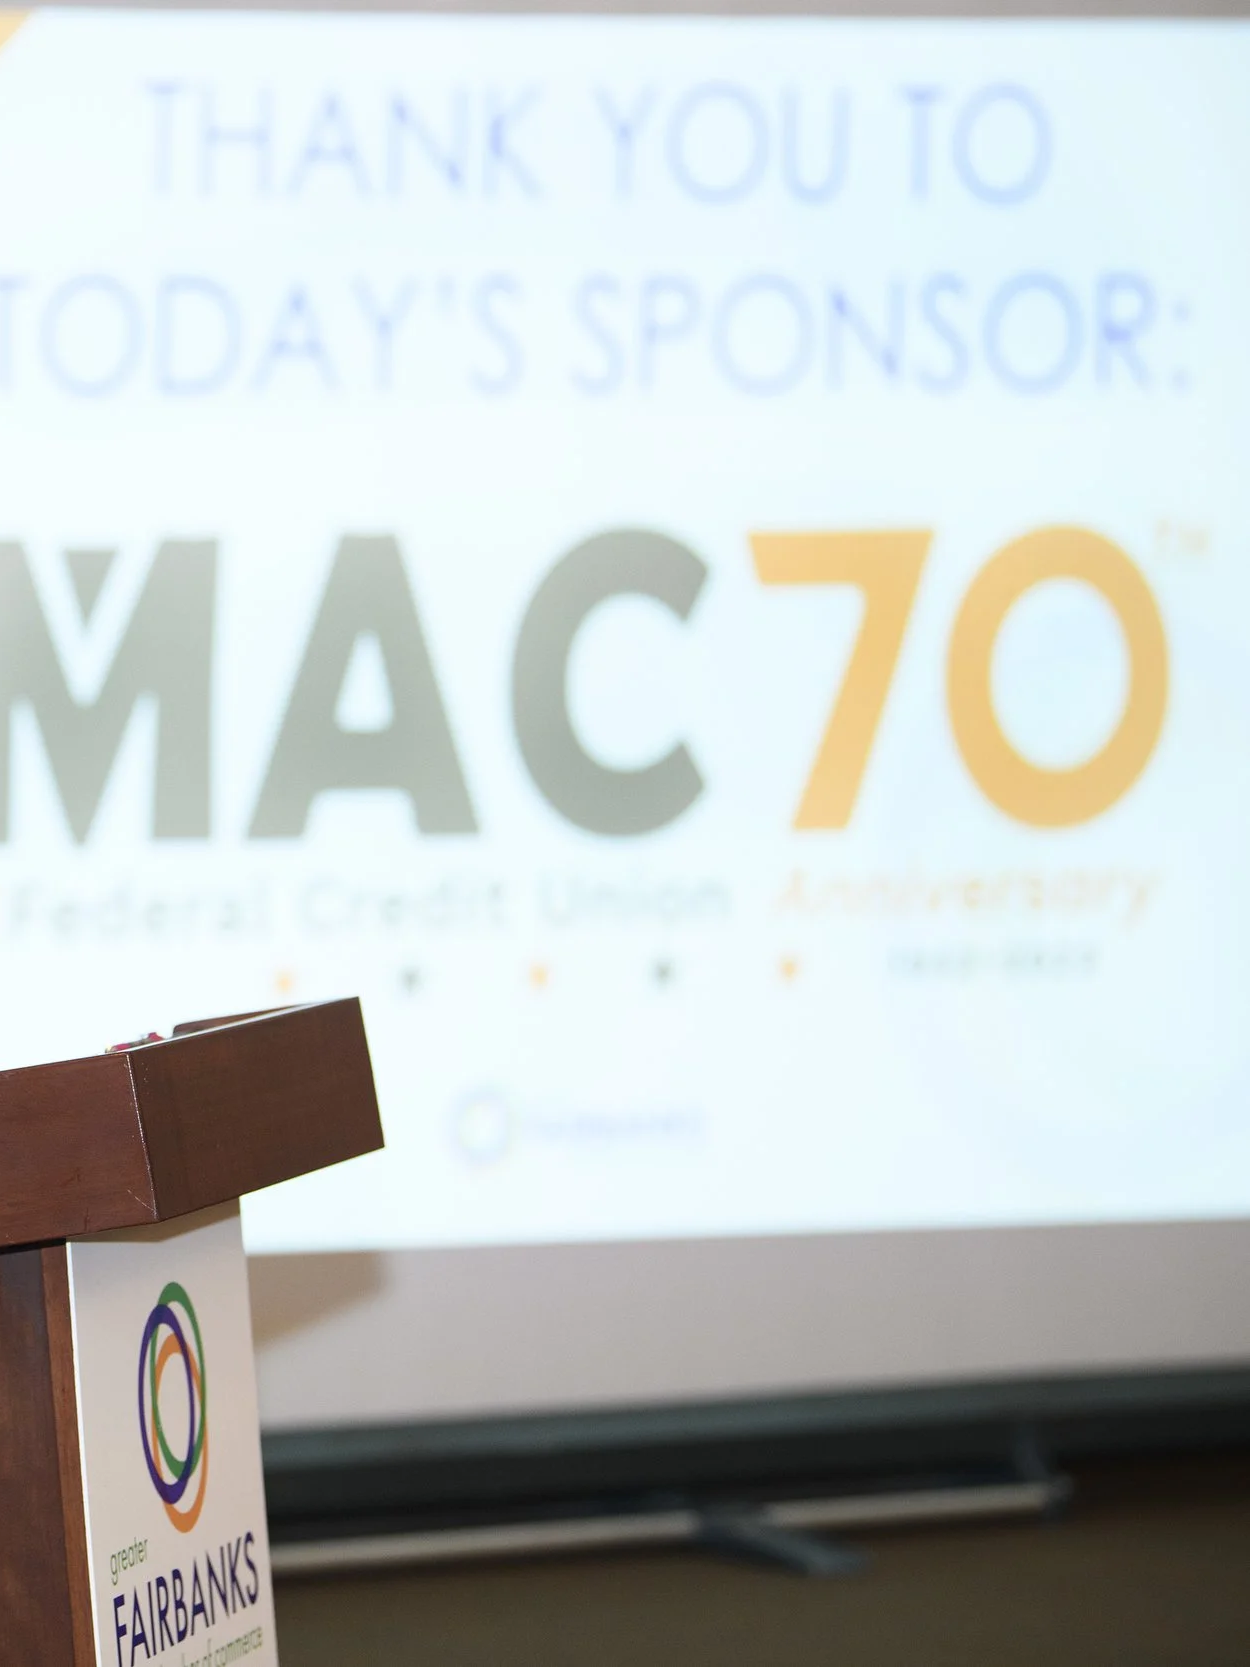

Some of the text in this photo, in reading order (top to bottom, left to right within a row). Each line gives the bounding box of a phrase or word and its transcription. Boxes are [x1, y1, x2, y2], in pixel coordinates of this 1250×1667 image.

[142, 78, 1056, 206] THANK YOU TO
[570, 270, 1196, 399] SPONSOR:
[747, 523, 1171, 833] 70
[7, 868, 732, 941] Federal Credit Union
[771, 866, 1162, 934] Anniversary
[110, 1537, 148, 1586] greater
[113, 1532, 259, 1667] FAIRBANKS
